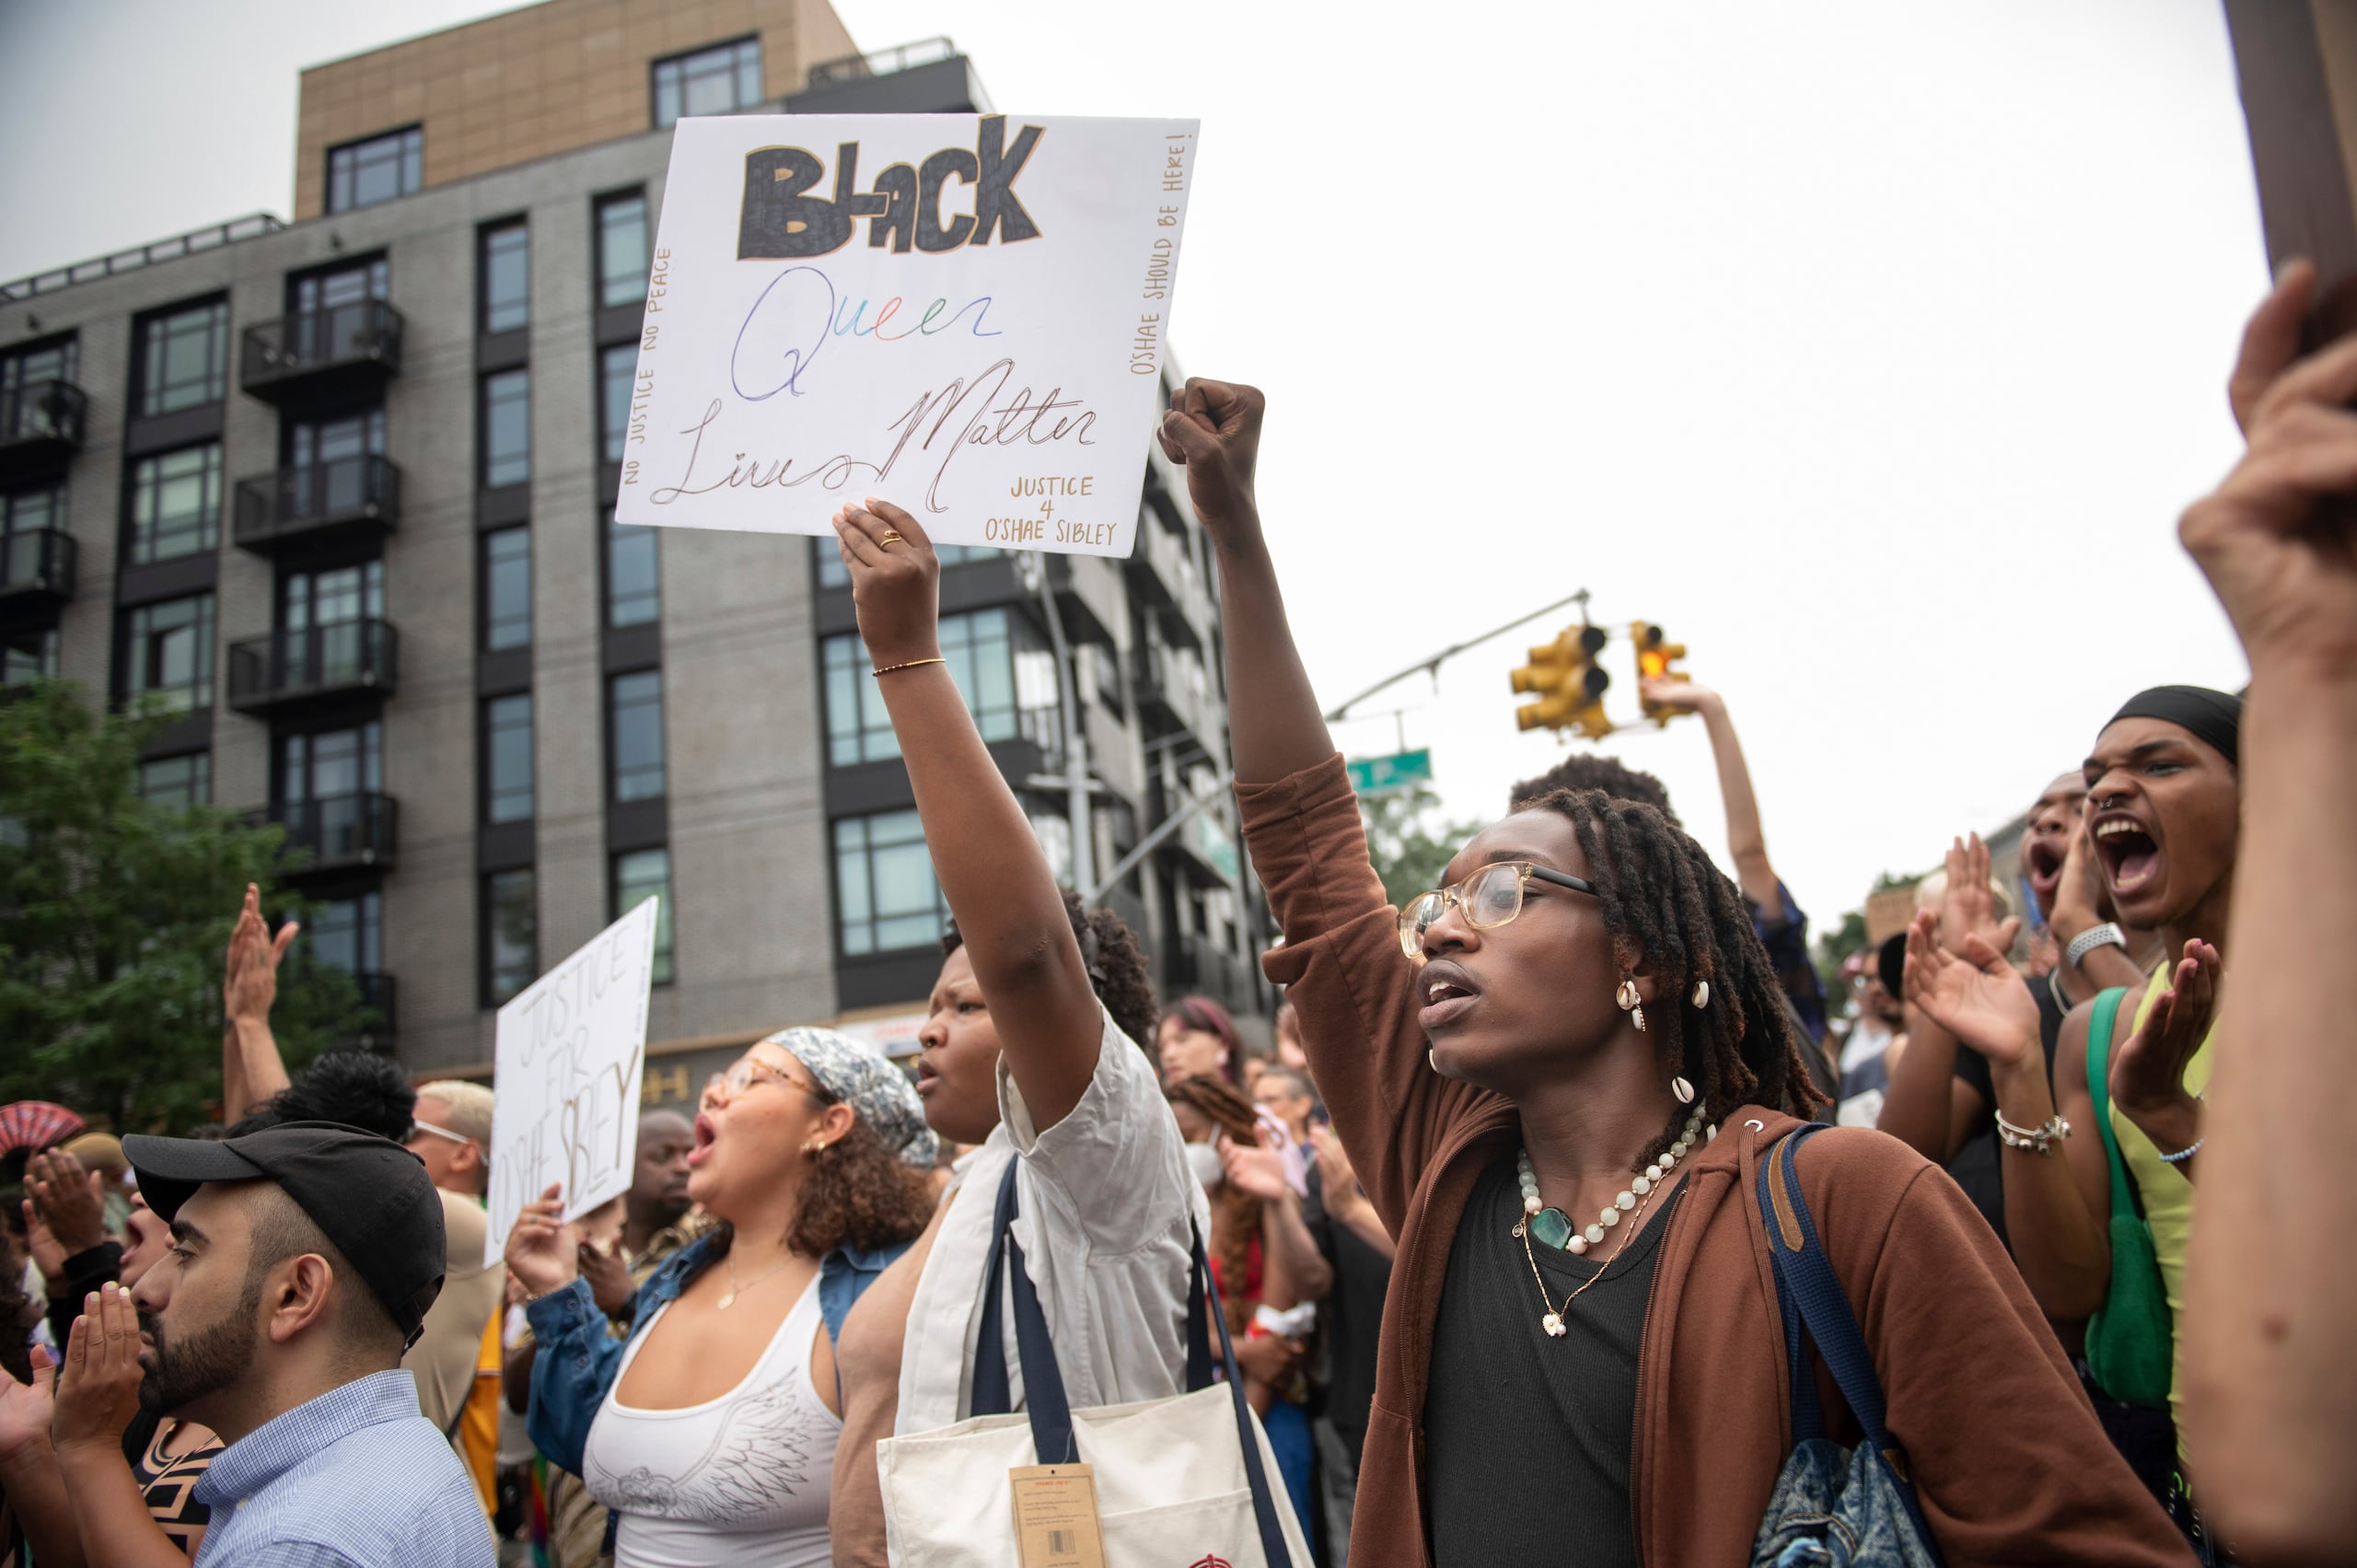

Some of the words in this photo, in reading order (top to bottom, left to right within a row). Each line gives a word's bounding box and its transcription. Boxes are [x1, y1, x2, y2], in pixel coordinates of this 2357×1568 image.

[737, 114, 1045, 261] BLACK
[1162, 134, 1192, 192] HERE!
[1156, 205, 1178, 227] BE
[647, 248, 671, 313] PEACE
[1143, 238, 1173, 300] SHOULD
[643, 325, 659, 351] NO
[731, 266, 1004, 401] Queer
[1129, 313, 1159, 376] O'SHAE
[630, 368, 654, 444] JUSTICE
[650, 399, 870, 505] Lives
[877, 358, 1096, 513] Matter
[624, 460, 640, 485] NO
[1011, 475, 1094, 498] JUSTICE
[984, 517, 1045, 543] O'SHAE
[1056, 519, 1117, 546] SIBLEY
[1039, 500, 1054, 520] 4
[519, 924, 630, 1068] JUSTICE
[546, 1024, 590, 1109] FOR
